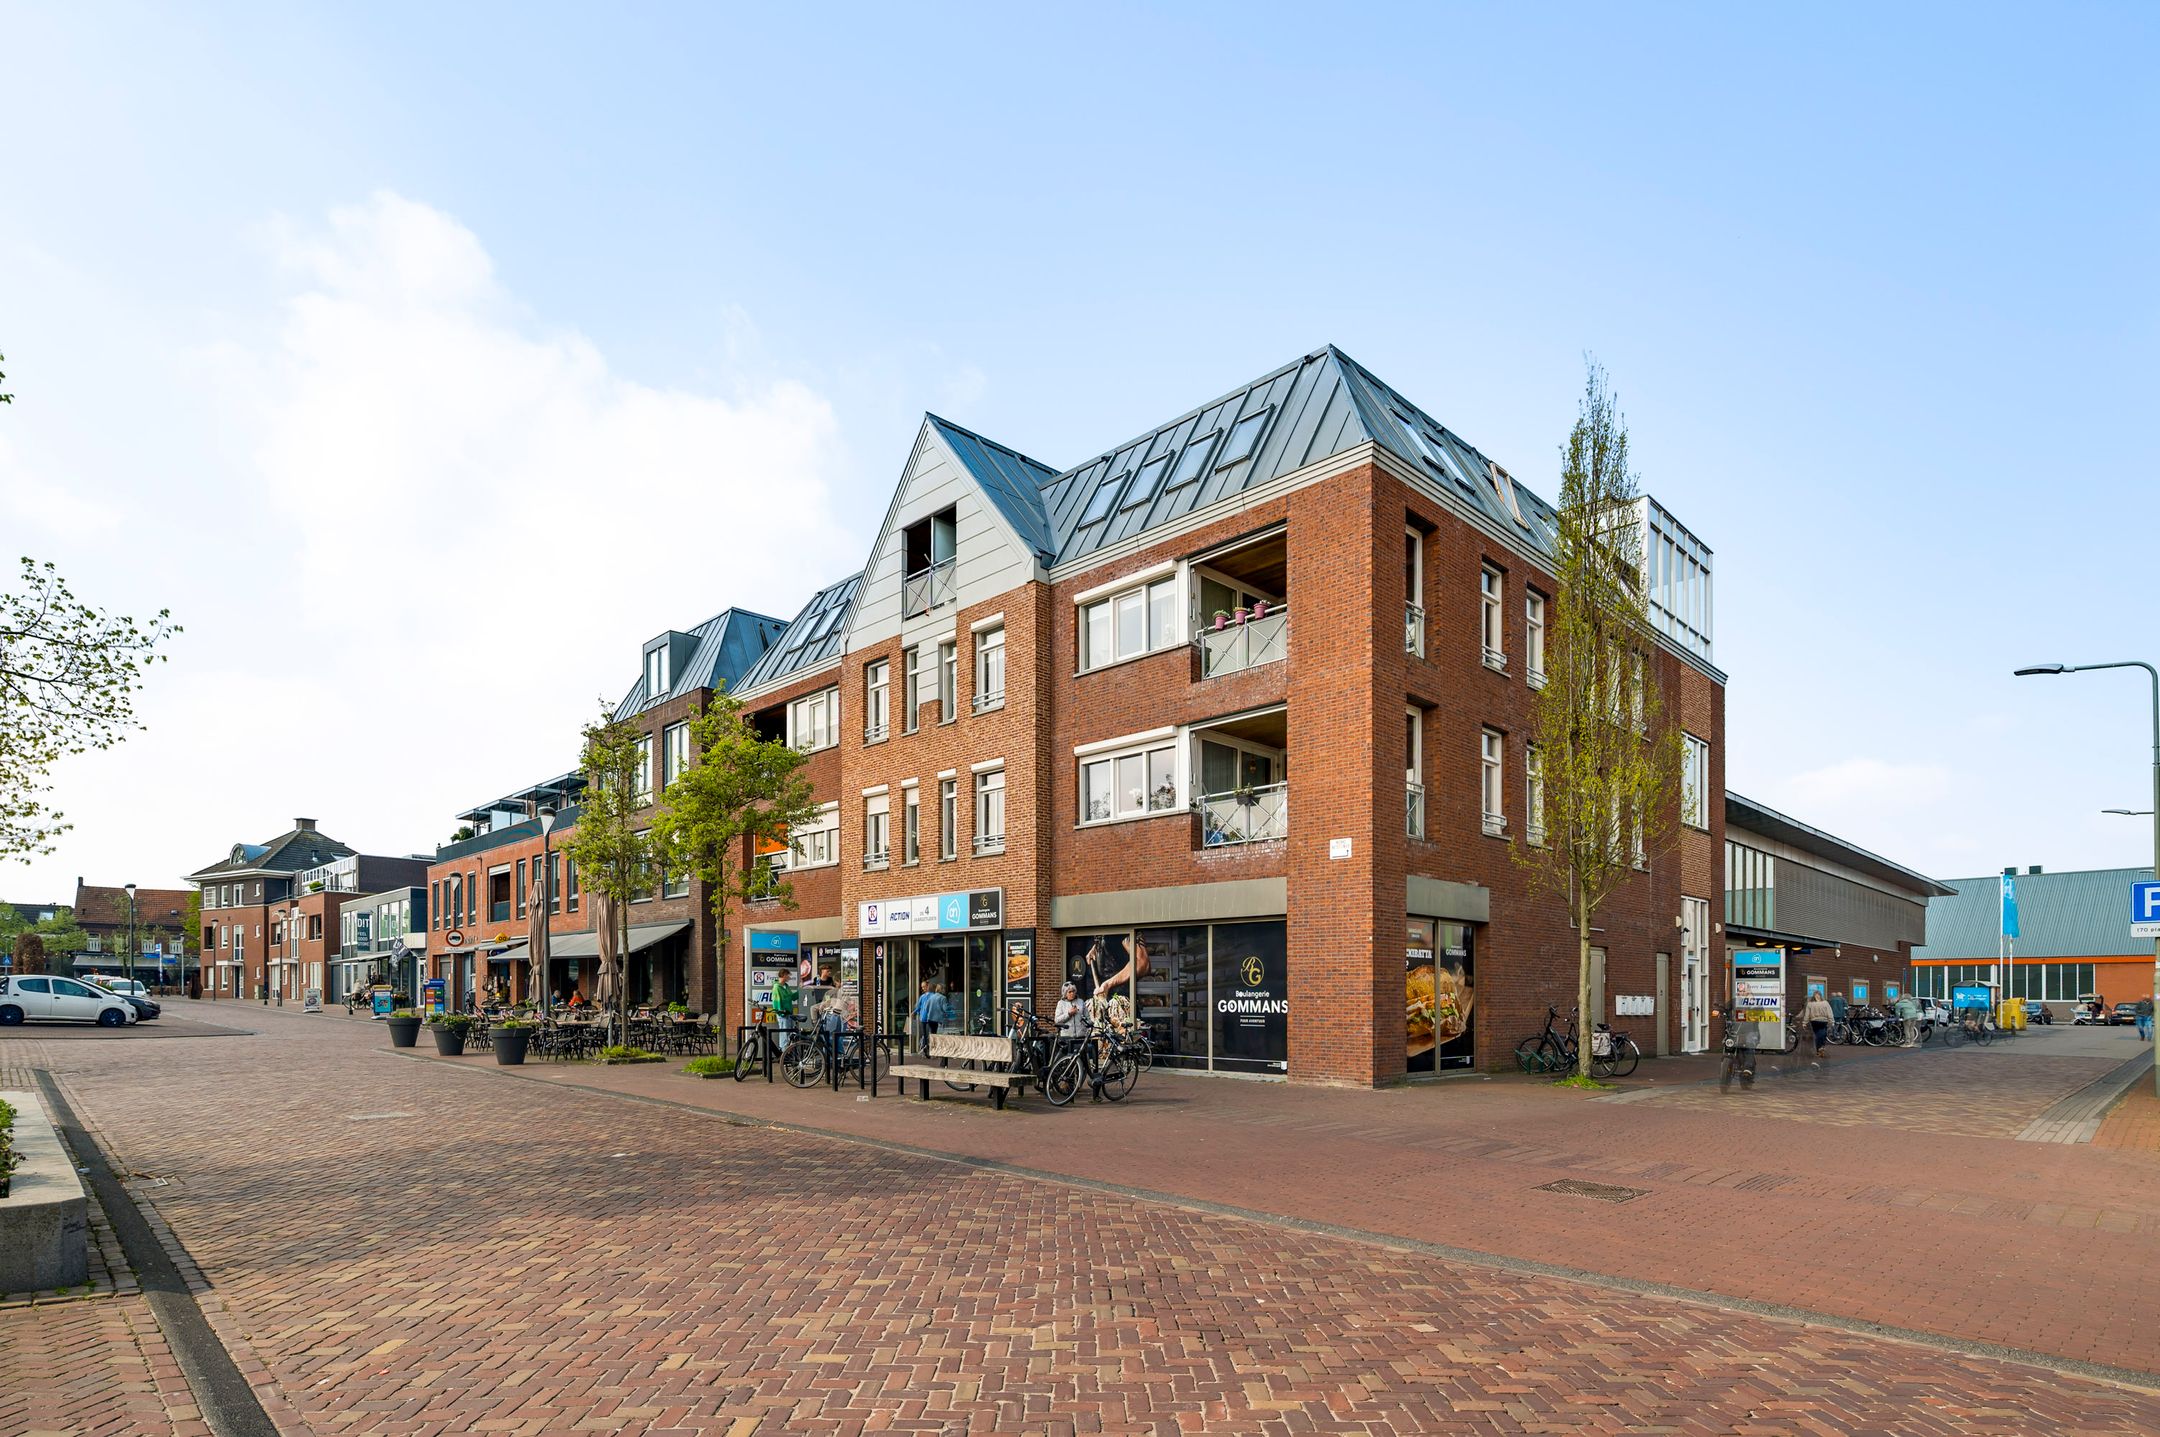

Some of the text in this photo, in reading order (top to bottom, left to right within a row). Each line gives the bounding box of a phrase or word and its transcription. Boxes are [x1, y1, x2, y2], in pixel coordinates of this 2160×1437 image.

[889, 911, 910, 921] ACTION
[1235, 990, 1270, 999] Boulangerie
[1218, 1000, 1288, 1013] GOMMANS
